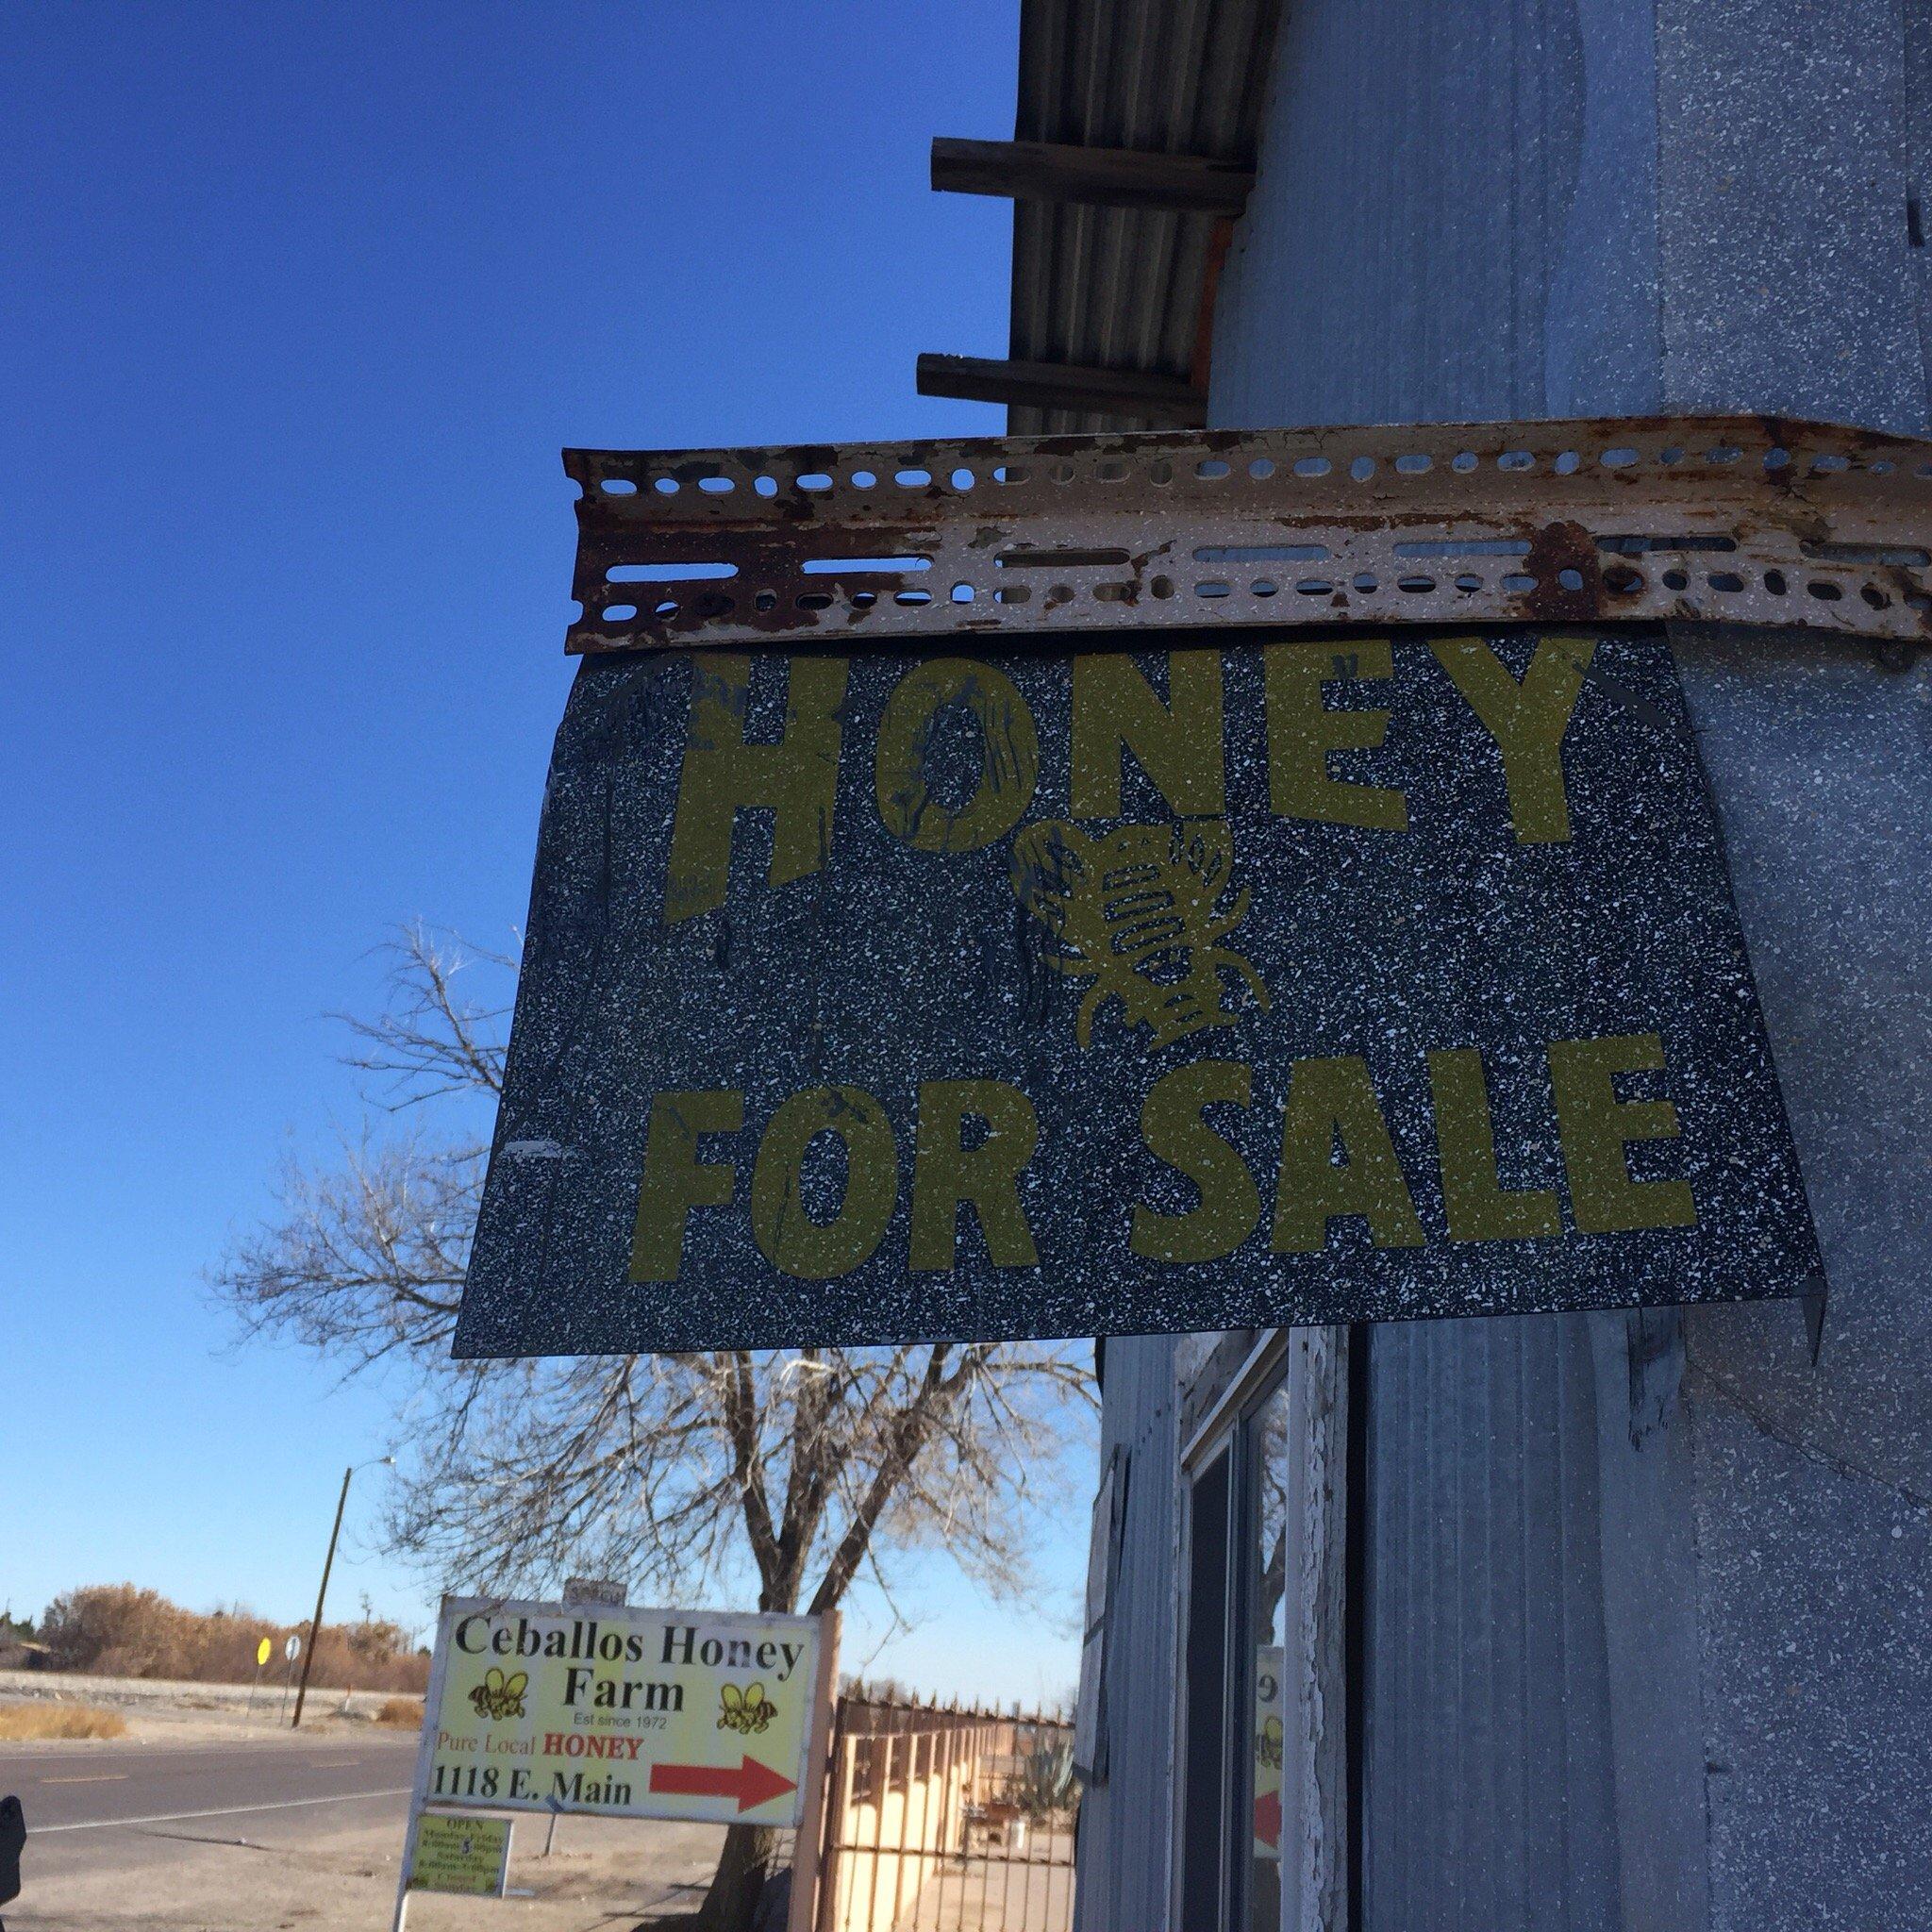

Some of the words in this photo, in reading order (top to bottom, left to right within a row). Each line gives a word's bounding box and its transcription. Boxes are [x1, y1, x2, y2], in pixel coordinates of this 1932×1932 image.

[664, 637, 1598, 926] HONEY
[630, 1079, 1042, 1285] FOR
[1130, 1032, 1698, 1266] SALE
[455, 1615, 643, 1663] Ceballos
[660, 1624, 805, 1682] Honey
[563, 1666, 683, 1712] Farm
[574, 1711, 595, 1726] Est
[597, 1713, 631, 1729] since
[636, 1716, 668, 1730] 1972
[437, 1731, 478, 1753] Pure
[484, 1732, 537, 1757] Local
[542, 1732, 645, 1761] HONEY
[434, 1764, 500, 1799] 1118
[508, 1768, 539, 1802] E.
[552, 1770, 632, 1807] Main
